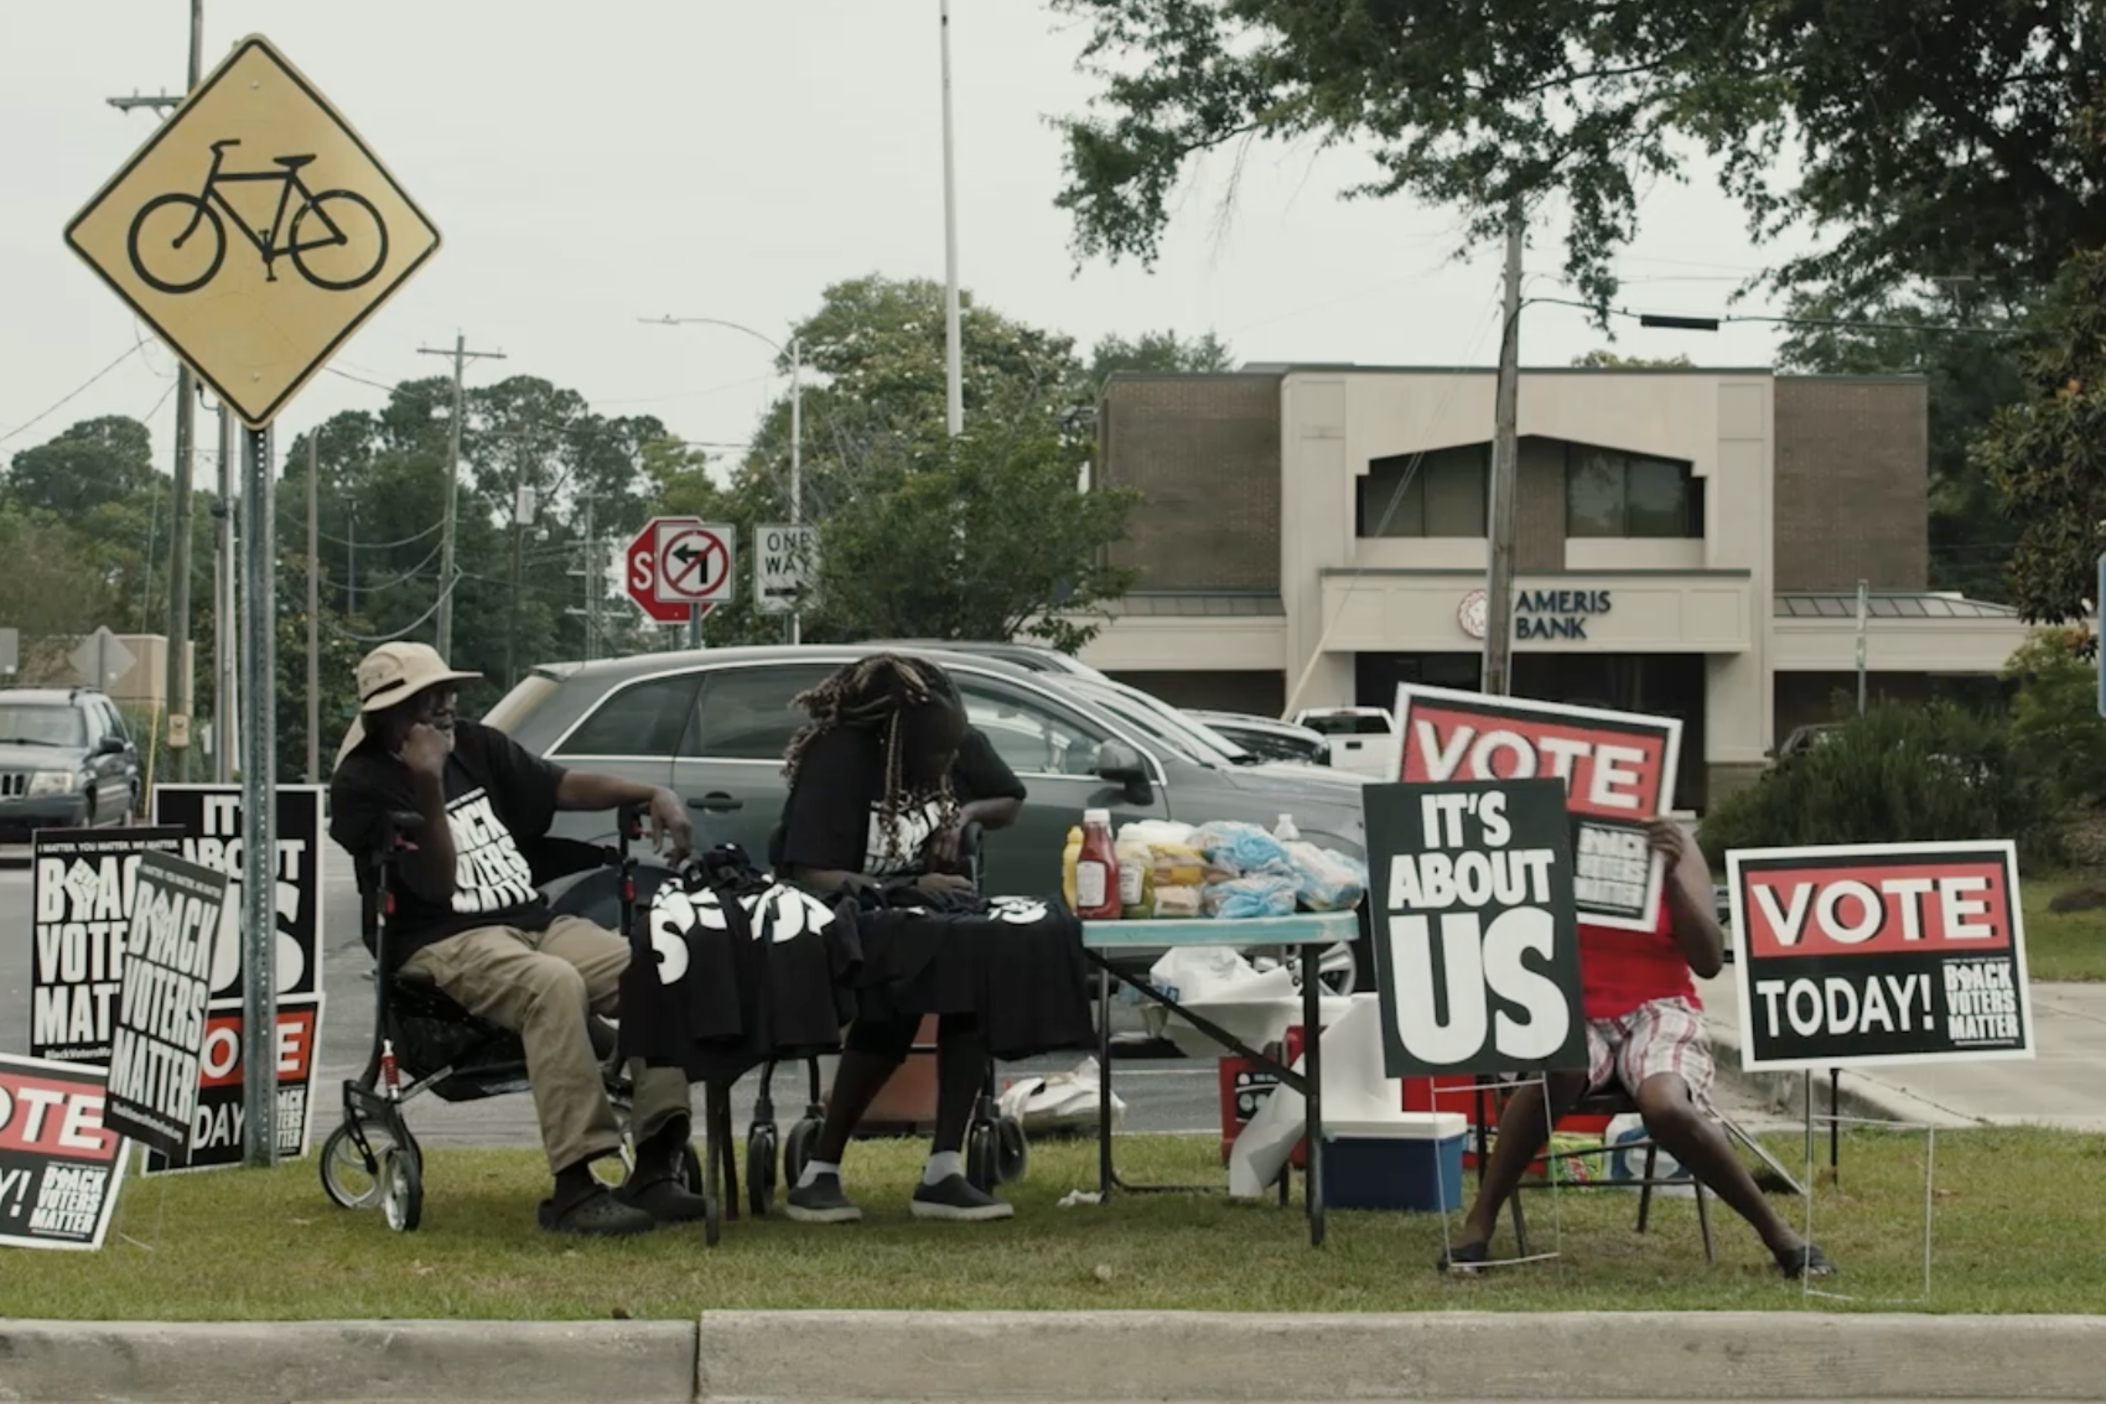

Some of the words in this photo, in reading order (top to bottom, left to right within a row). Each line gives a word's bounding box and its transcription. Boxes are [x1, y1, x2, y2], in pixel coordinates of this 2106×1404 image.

[765, 556, 811, 574] WAY
[1515, 590, 1611, 614] AMERIS
[1516, 617, 1588, 640] BANK
[1414, 719, 1646, 809] VOTE
[1421, 790, 1511, 848] IT'S
[1388, 849, 1555, 909] ABOUT
[1752, 876, 1996, 946] VOTE
[33, 983, 121, 1046] MAT
[120, 953, 208, 1053] VOTERS
[1389, 906, 1570, 1064] US
[1756, 974, 1934, 1037] TODAY!
[1946, 989, 2016, 1015] VOTERS
[1947, 1012, 2019, 1040] MATTER
[108, 1025, 198, 1126] MATTER
[29, 1207, 96, 1234] MATTER
[37, 1187, 102, 1215] VOTERS
